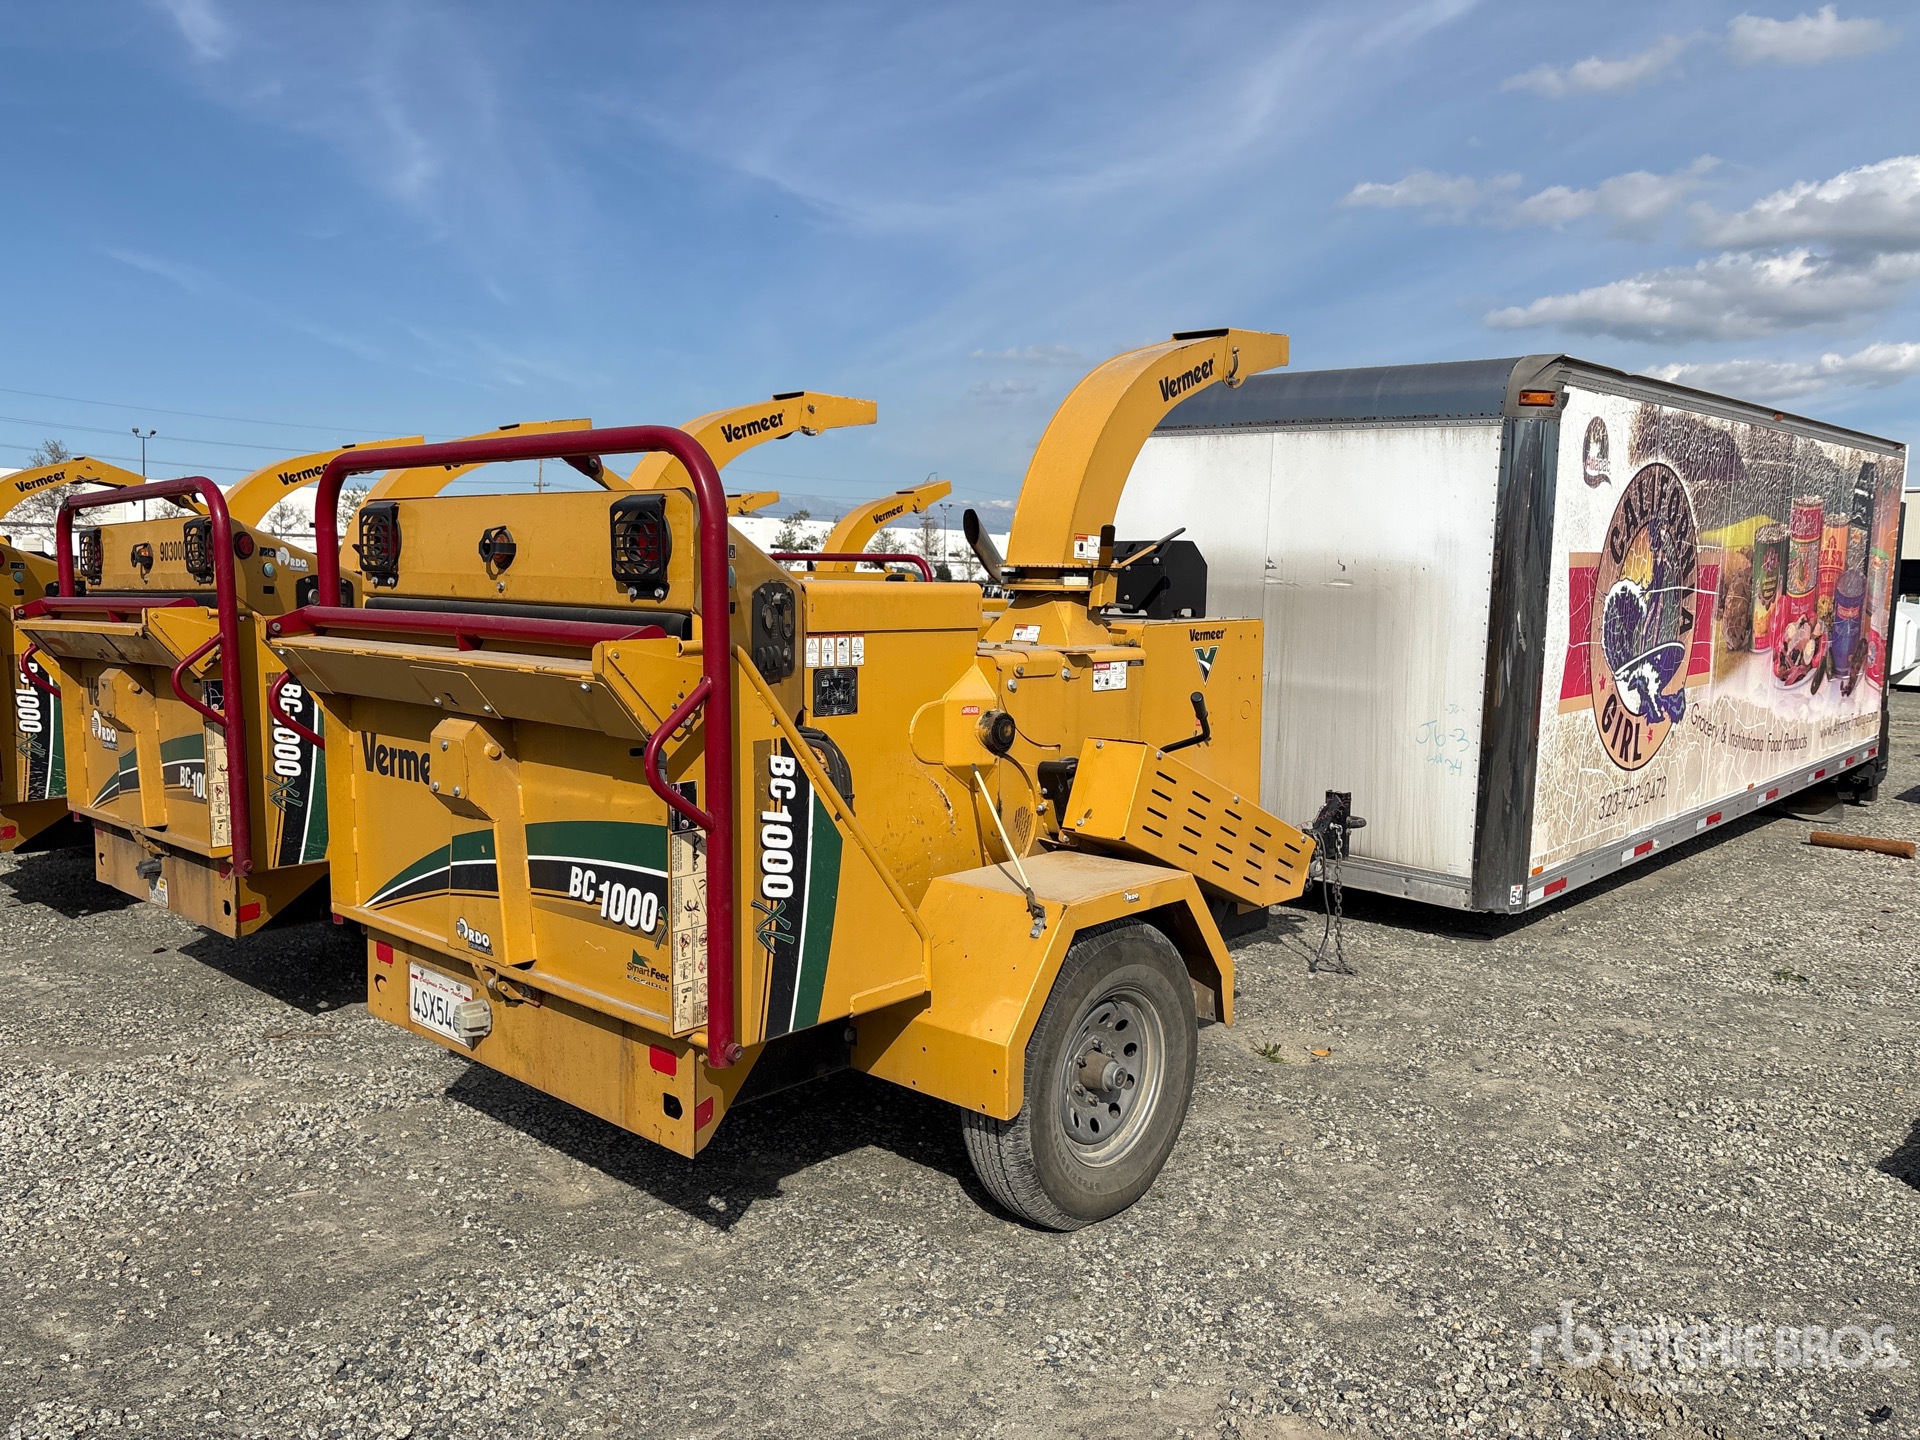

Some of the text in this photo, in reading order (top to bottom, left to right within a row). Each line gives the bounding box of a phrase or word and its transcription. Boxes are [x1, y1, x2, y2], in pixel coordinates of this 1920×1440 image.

[1158, 357, 1214, 402] Vermeer
[720, 411, 784, 443] Vermeer
[14, 470, 66, 493] Vermeer
[277, 463, 329, 486] Verme
[872, 502, 905, 525] Vermeer
[290, 557, 307, 568] RDO
[1610, 474, 1695, 636] CALIFORNIA
[1189, 628, 1225, 642] Vermeer
[102, 726, 117, 742] RDO
[1602, 694, 1642, 762] GIRL
[1691, 703, 1719, 747] Grocery
[1720, 722, 1728, 743] &
[1767, 731, 1783, 752] Food
[1783, 729, 1808, 752] Products
[361, 730, 430, 786] Verme
[180, 766, 207, 800] BC10
[1599, 776, 1667, 820] 323-722-2472
[468, 928, 490, 947] RDO
[413, 986, 460, 1034] 4SX54
